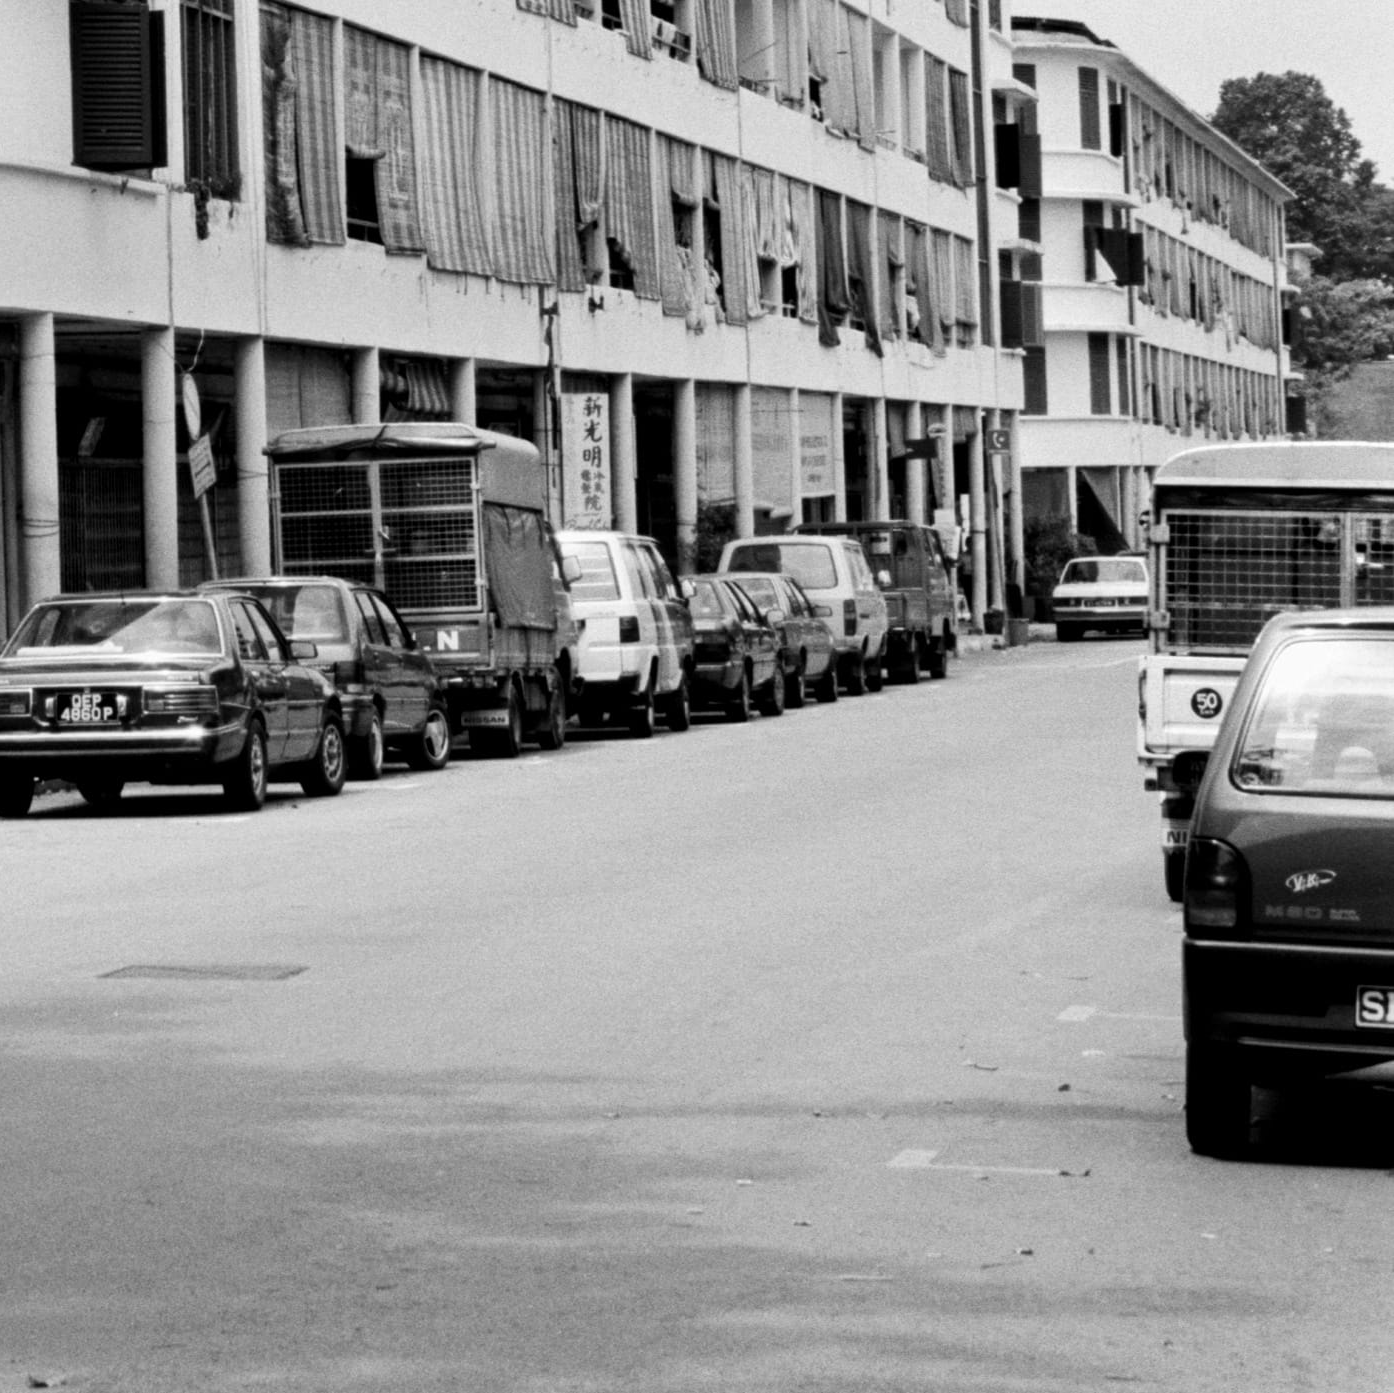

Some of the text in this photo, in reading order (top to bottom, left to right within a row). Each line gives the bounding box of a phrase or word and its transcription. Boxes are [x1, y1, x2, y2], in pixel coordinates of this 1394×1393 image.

[583, 395, 603, 469] 新光明
[1196, 692, 1219, 710] 50
